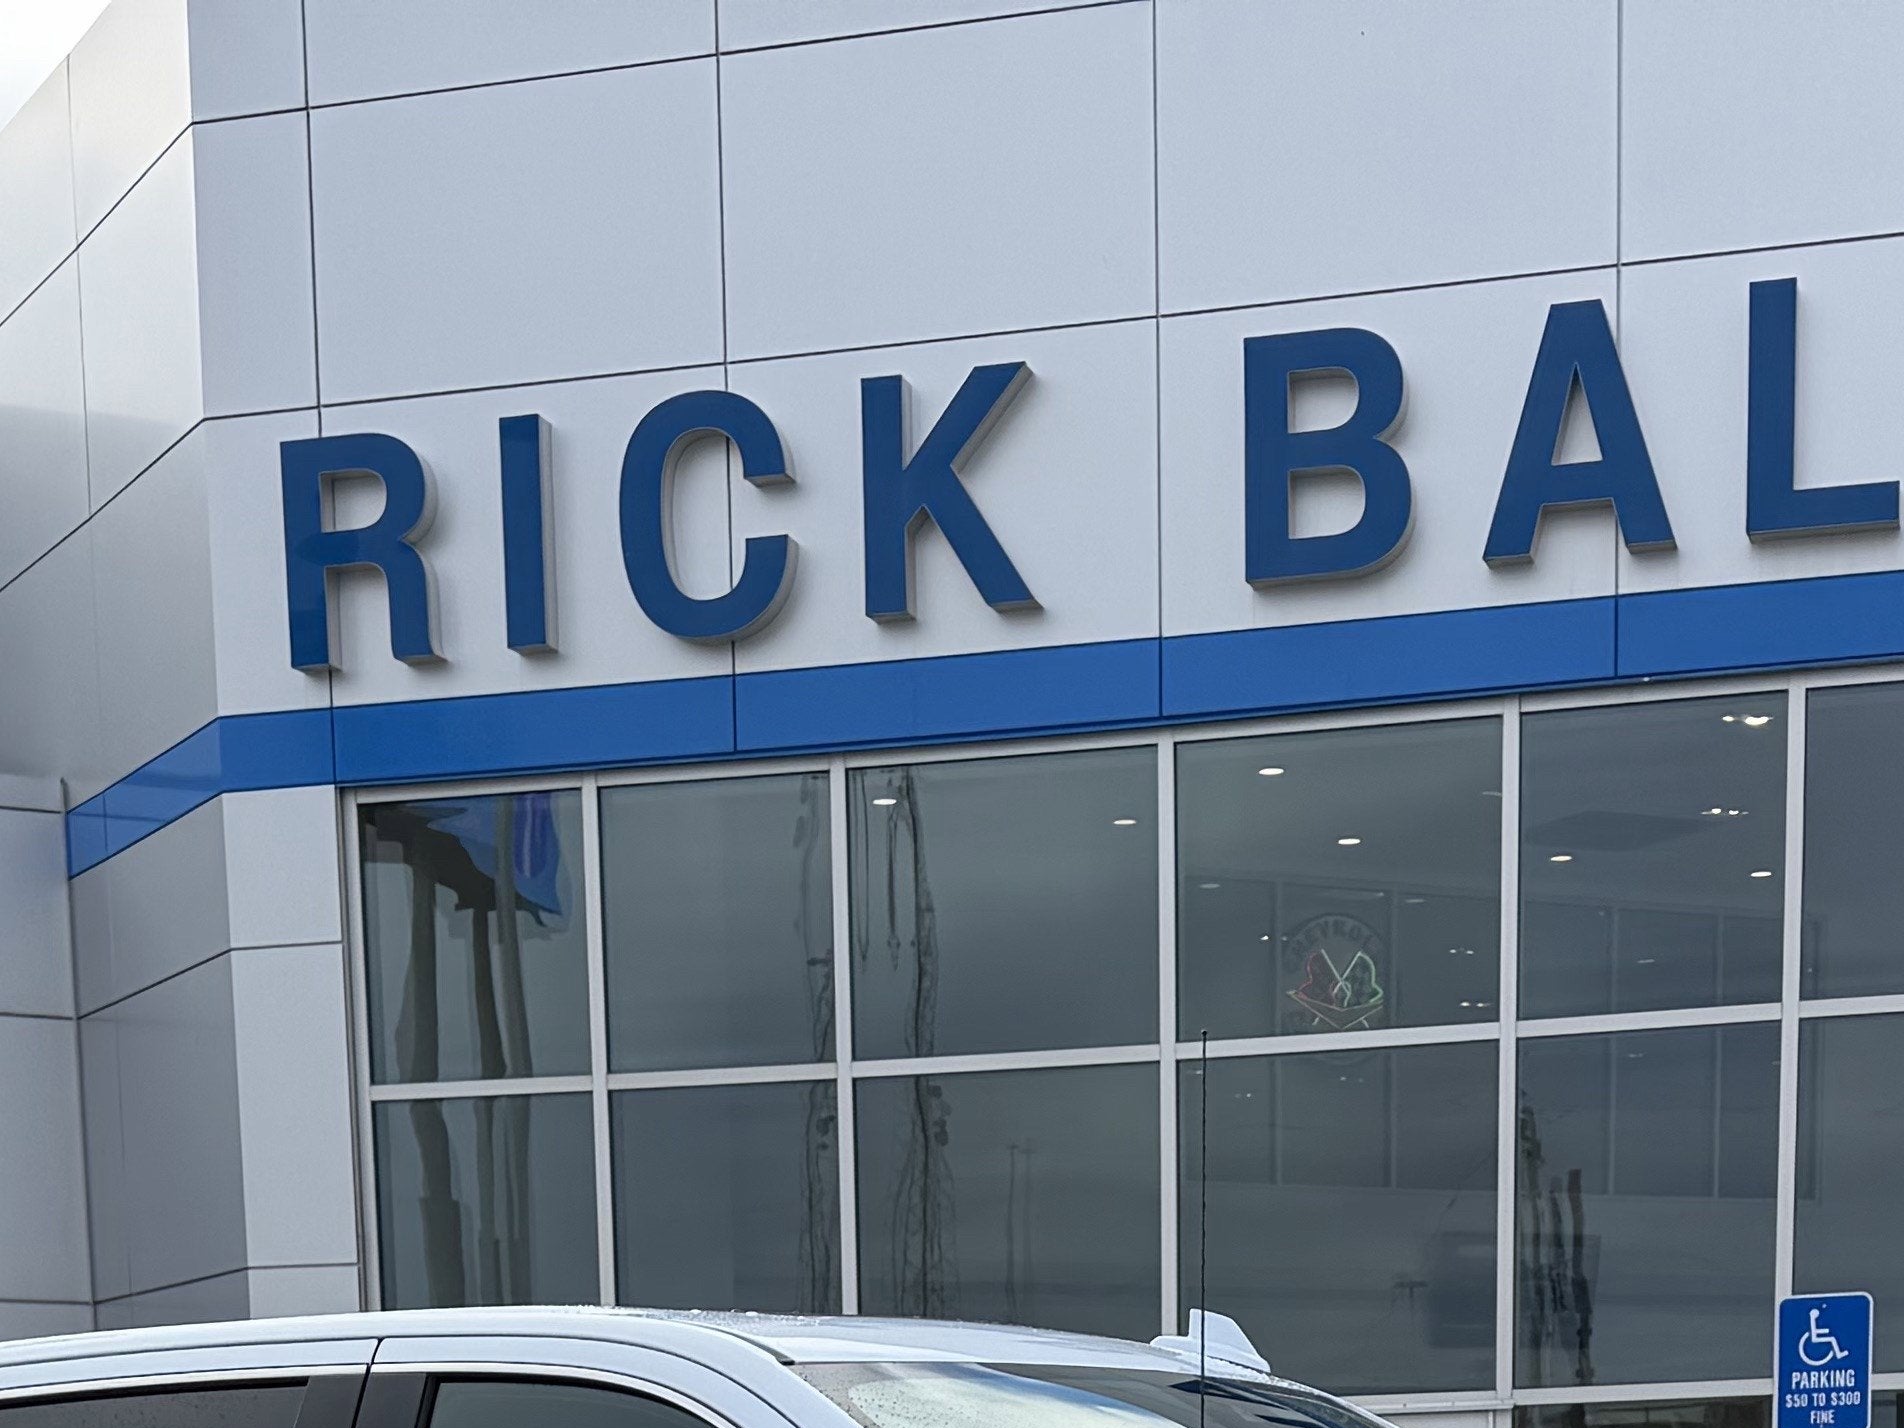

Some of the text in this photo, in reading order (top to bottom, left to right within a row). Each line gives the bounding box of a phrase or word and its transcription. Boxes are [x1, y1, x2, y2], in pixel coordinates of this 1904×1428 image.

[277, 360, 1044, 677] RICK
[1792, 1369, 1855, 1389] PARKING
[1785, 1391, 1861, 1408] $50 TO $300
[1810, 1409, 1835, 1424] FINE
